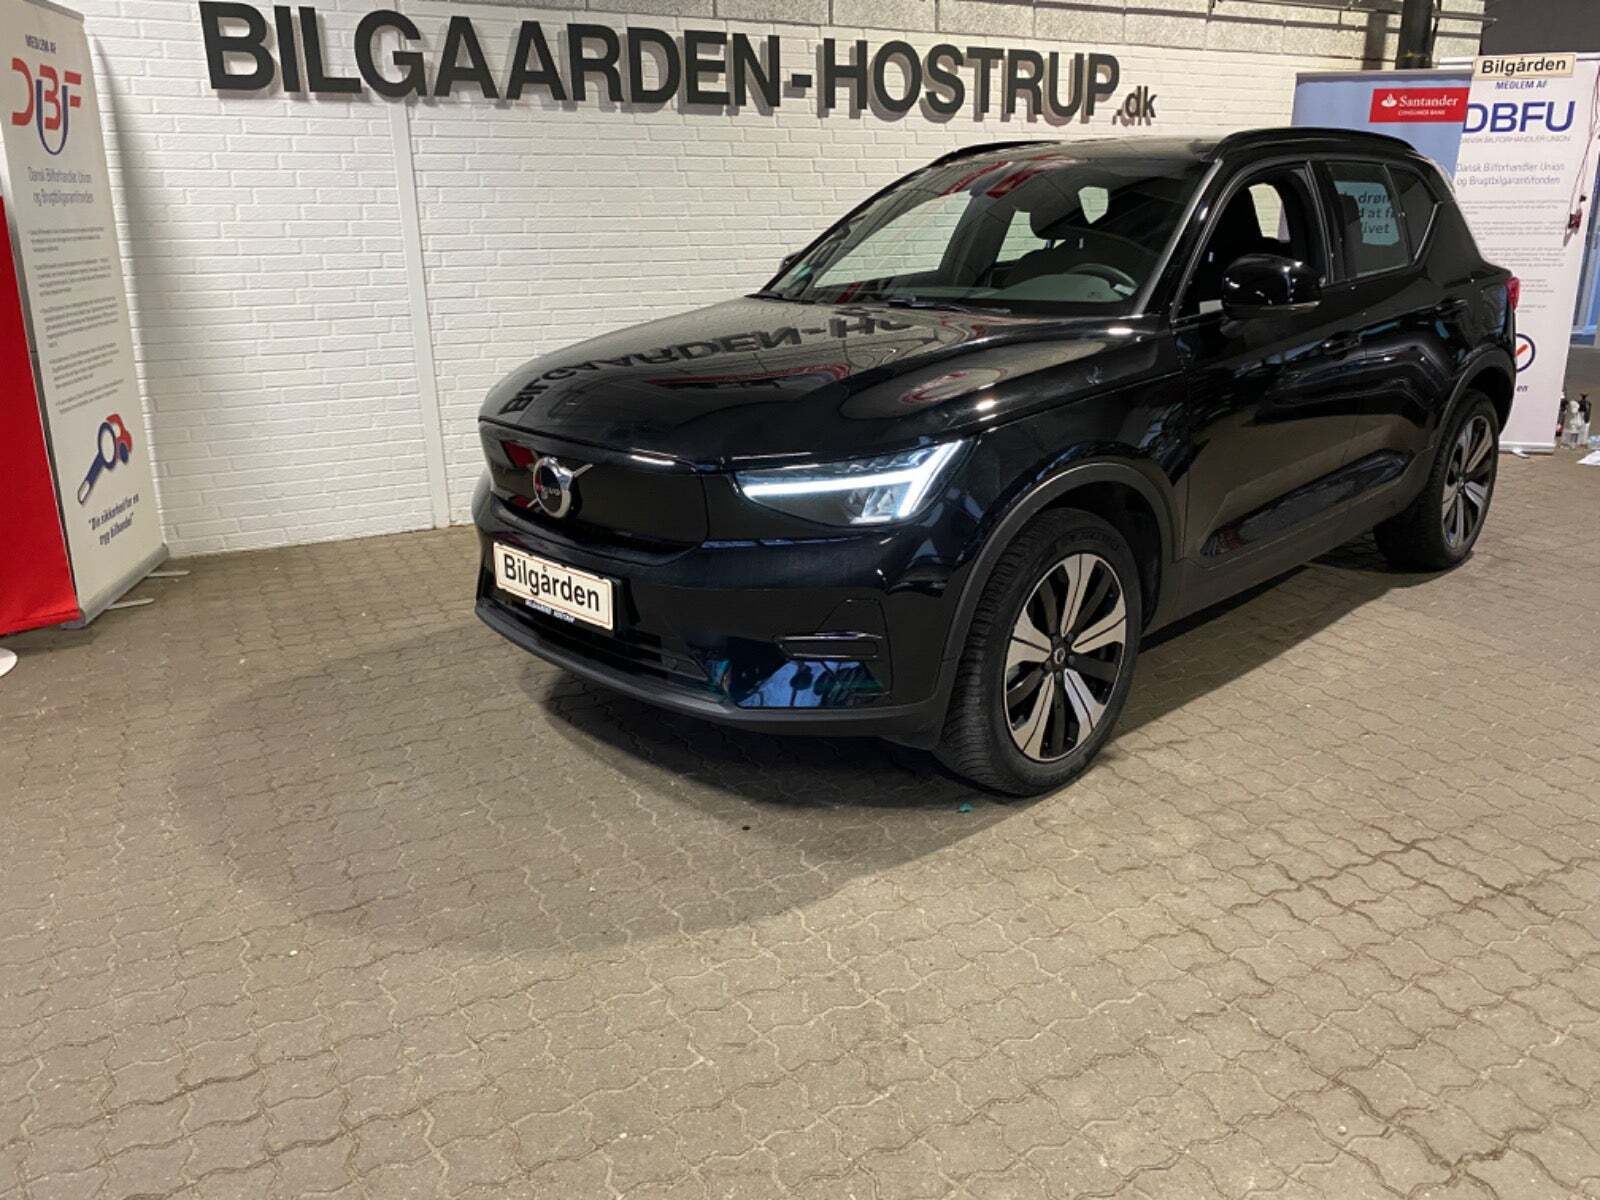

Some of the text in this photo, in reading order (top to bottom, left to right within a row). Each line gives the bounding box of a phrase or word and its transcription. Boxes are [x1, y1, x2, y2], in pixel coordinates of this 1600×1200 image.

[1481, 57, 1567, 76] Bilgården
[1495, 80, 1534, 90] MEDLEM
[1399, 94, 1459, 108] Santander
[1462, 101, 1576, 133] DBFU
[504, 553, 600, 612] Bilgården
